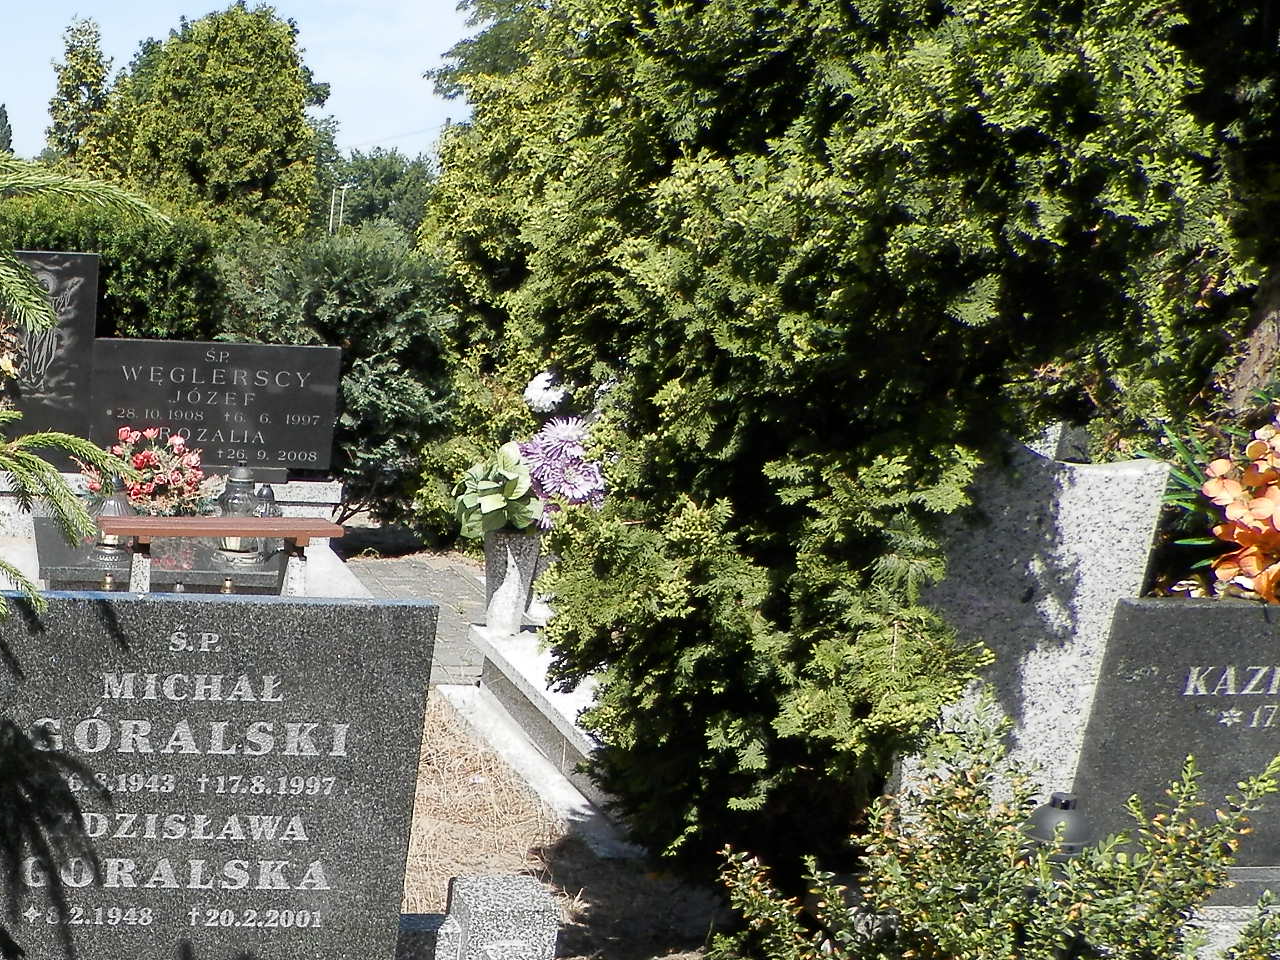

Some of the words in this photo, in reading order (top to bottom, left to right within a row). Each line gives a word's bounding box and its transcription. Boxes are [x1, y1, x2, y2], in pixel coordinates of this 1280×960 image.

[121, 365, 312, 389] WĘGLERSCY
[285, 413, 320, 426] 1997
[158, 427, 266, 445] ROZALIA
[277, 451, 318, 463] 2008
[101, 671, 284, 703] MICHAŁ
[30, 706, 351, 757] GÓRALSKI
[60, 812, 310, 842] DZISŁAWA
